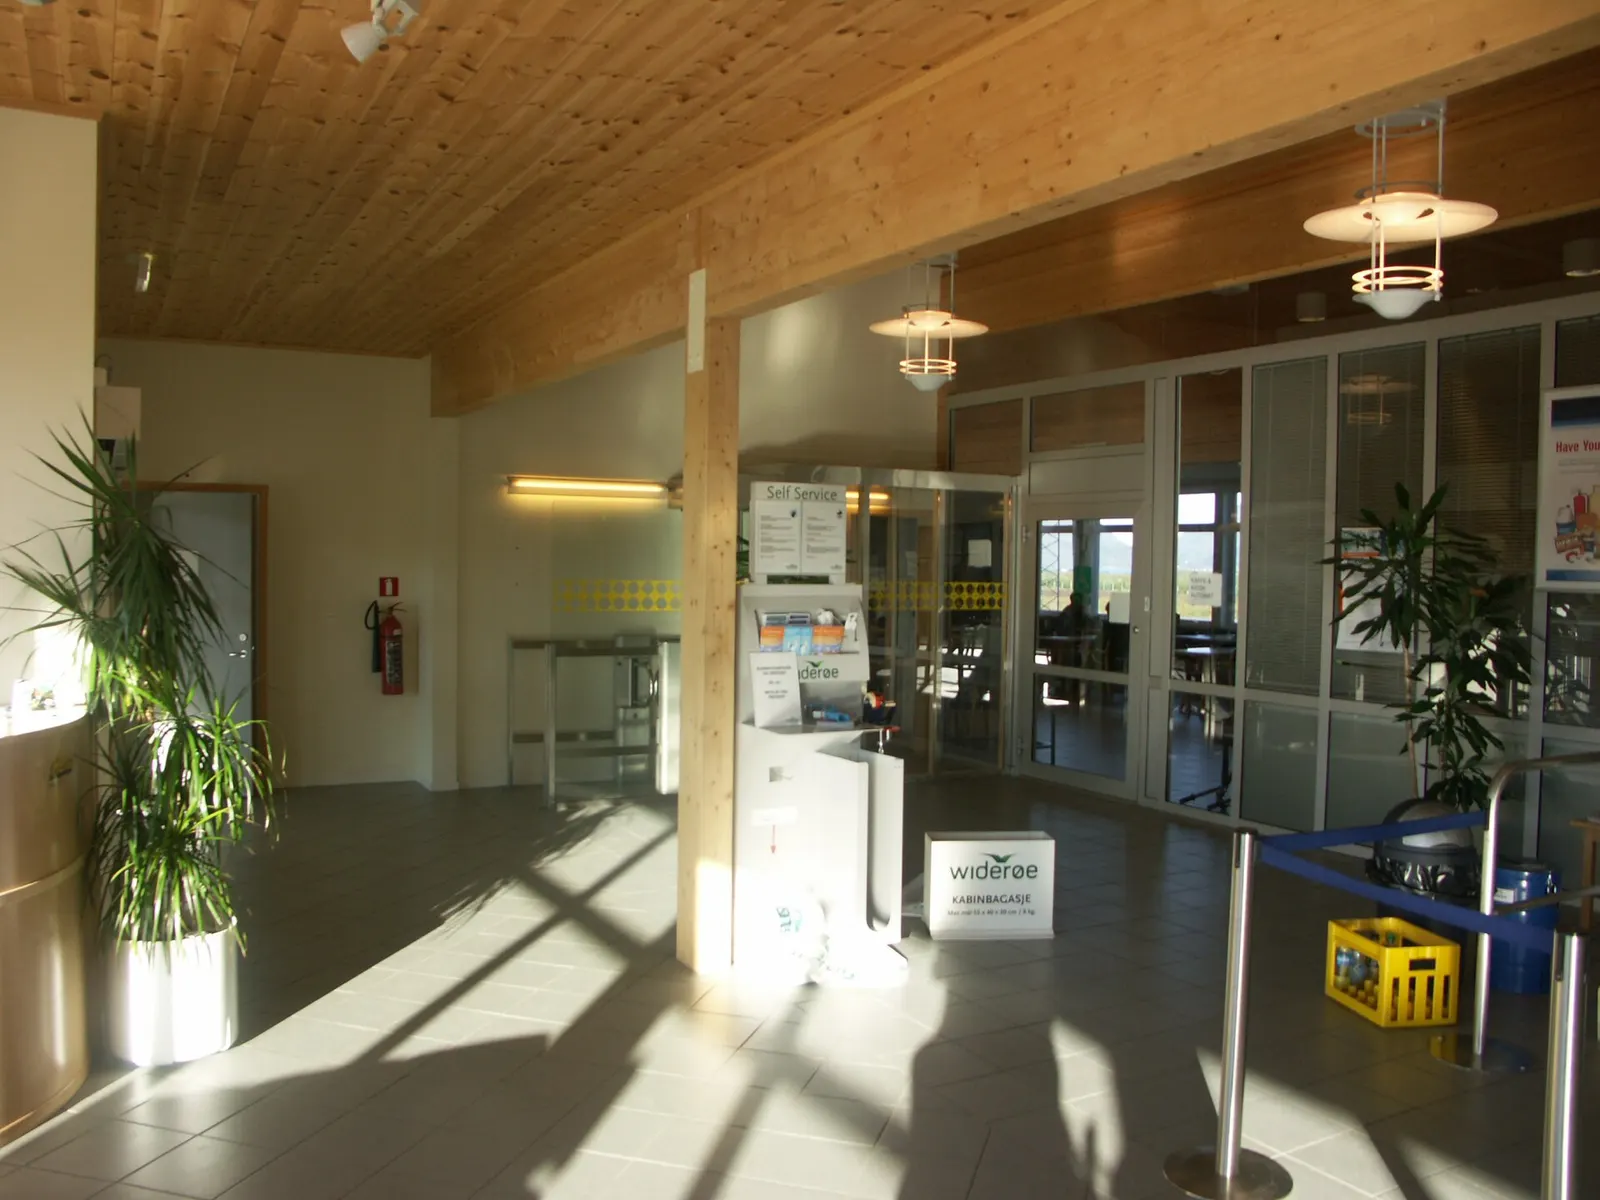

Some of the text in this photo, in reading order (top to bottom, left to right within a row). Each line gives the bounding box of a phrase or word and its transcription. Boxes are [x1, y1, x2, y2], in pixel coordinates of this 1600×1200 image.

[1556, 439, 1600, 453] Have You
[767, 484, 838, 501] Self Service
[798, 666, 839, 680] iderøe
[949, 860, 1038, 880] widerøe
[952, 894, 1031, 905] KABINBAGASJE
